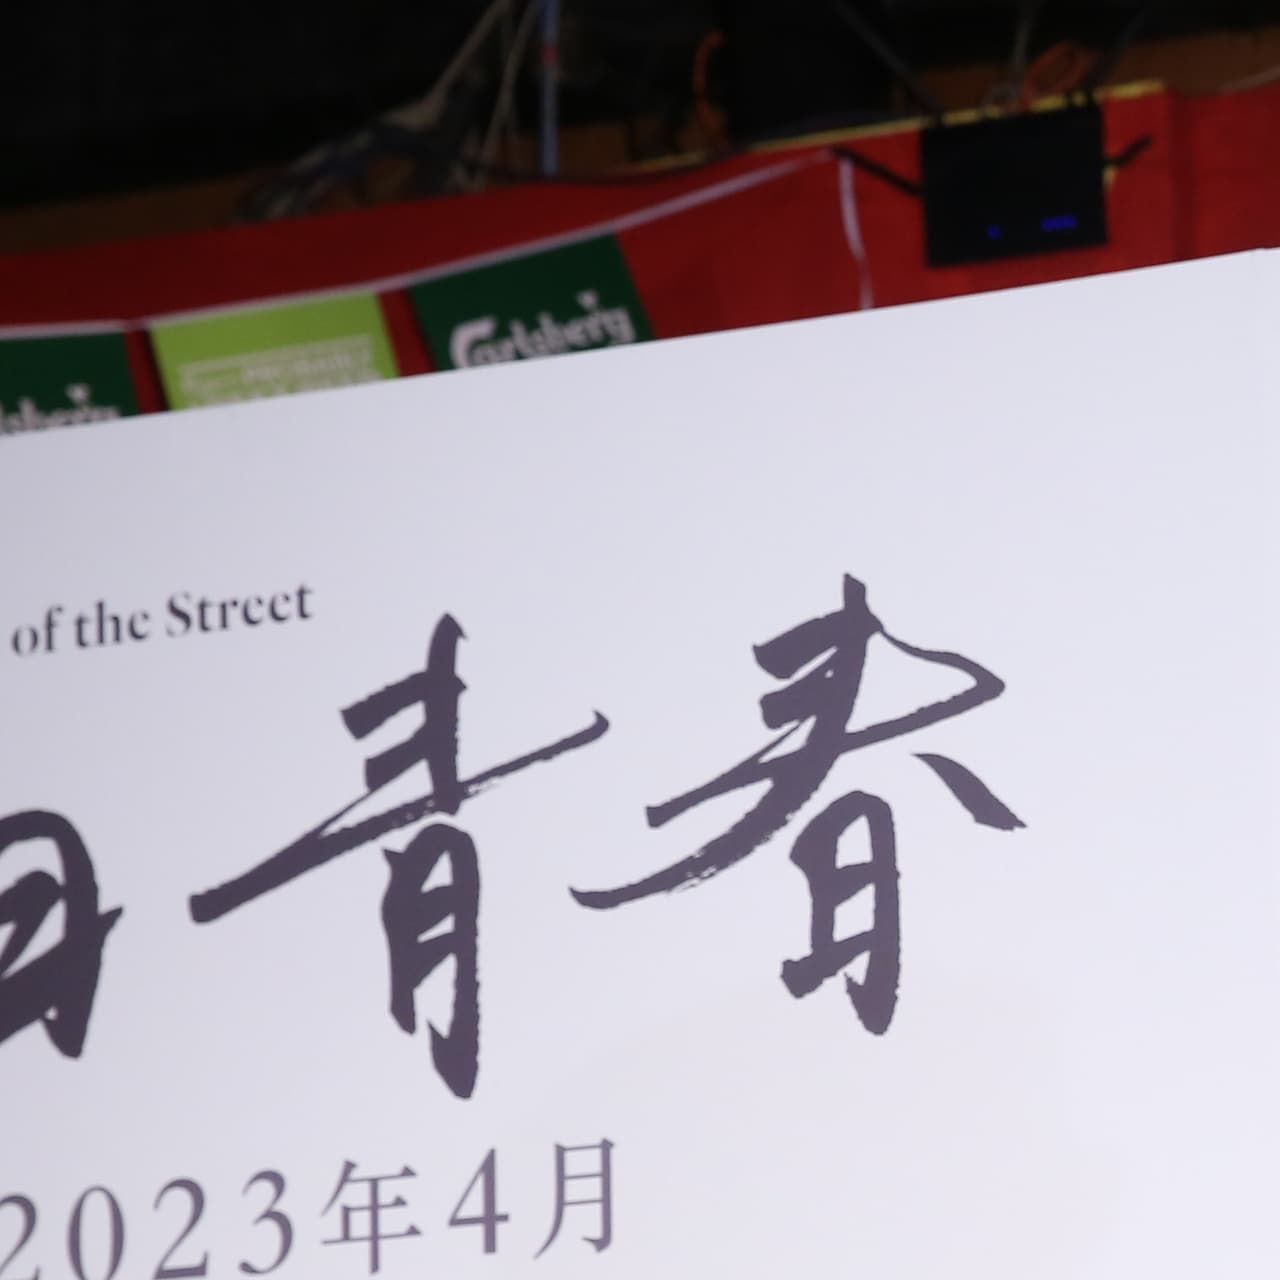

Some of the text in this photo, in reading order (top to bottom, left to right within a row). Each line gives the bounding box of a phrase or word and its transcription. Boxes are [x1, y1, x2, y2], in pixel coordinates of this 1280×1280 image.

[11, 585, 313, 657] of the Street
